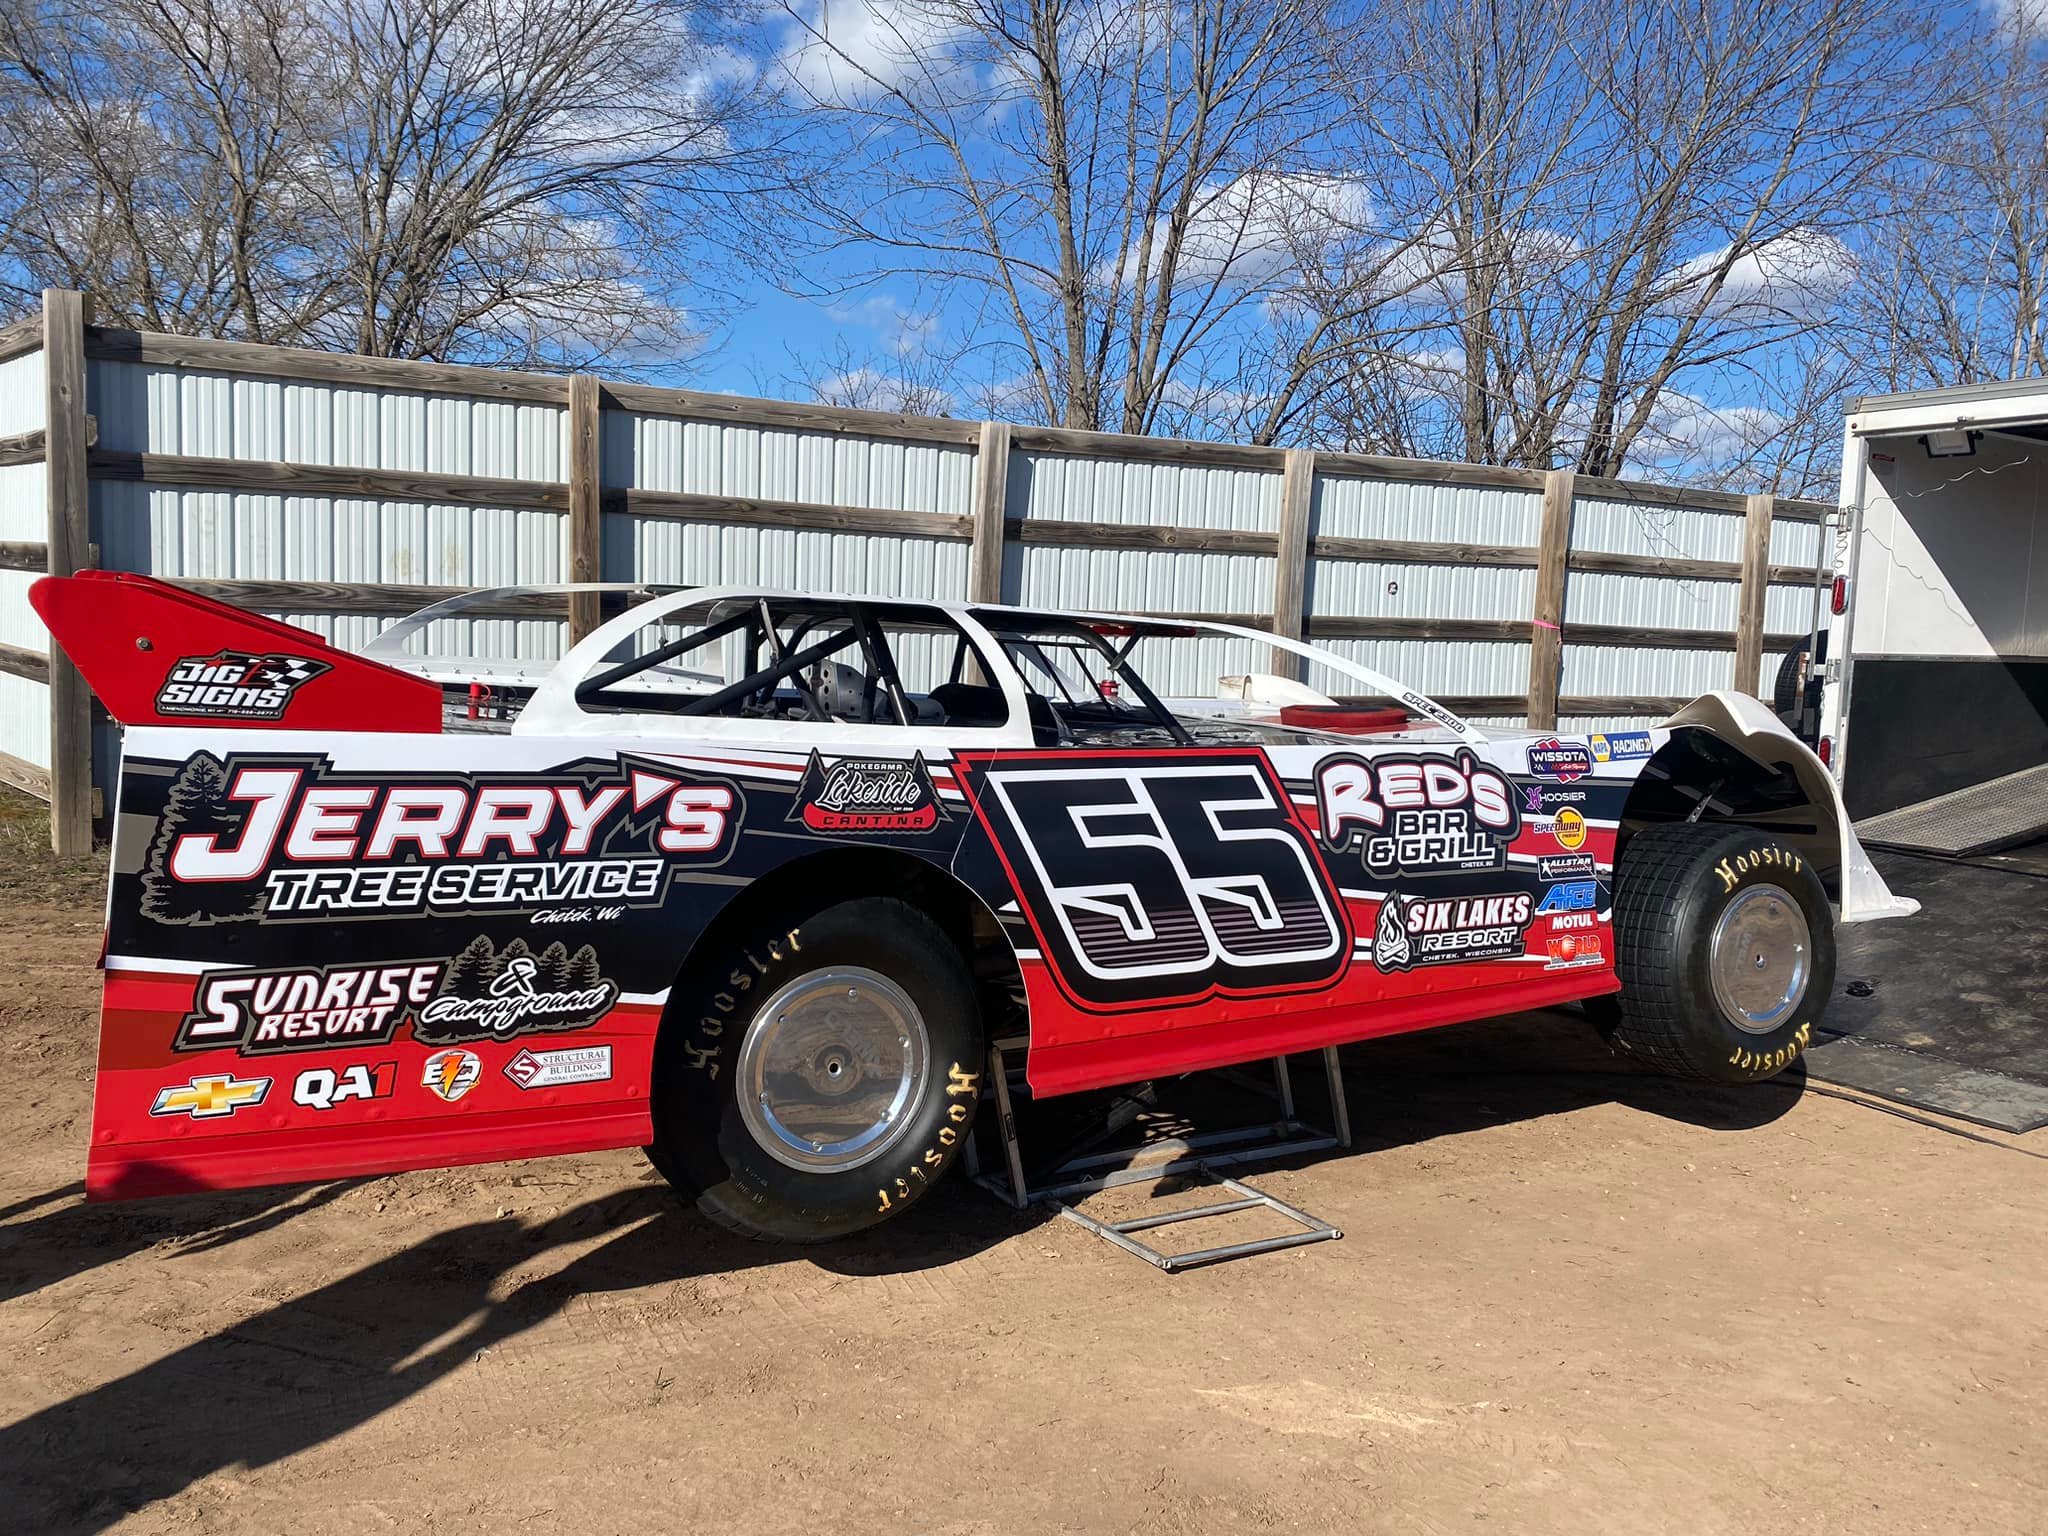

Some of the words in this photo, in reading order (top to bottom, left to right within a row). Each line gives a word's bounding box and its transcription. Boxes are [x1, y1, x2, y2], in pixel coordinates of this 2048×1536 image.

[160, 683, 287, 708] SIGNS
[1402, 691, 1436, 714] SPEC
[1531, 751, 1587, 762] WISSOTA
[1613, 738, 1645, 754] RACING
[846, 762, 904, 771] POKEGAMA
[814, 766, 922, 811] Lakeside
[1321, 758, 1510, 840] RED'S
[1539, 791, 1587, 802] HOOSIER
[170, 767, 733, 883] JERRY'S
[822, 816, 925, 826] CANTINA
[1395, 808, 1468, 839] BAR
[1533, 821, 1581, 834] SPEEDWAY
[1397, 832, 1496, 865] GRILL
[1549, 857, 1592, 867] ALLSTAR
[986, 765, 1341, 980] 55
[1714, 841, 1802, 894] Hoosier
[264, 864, 429, 912] TREE
[425, 858, 665, 910] SERVICE
[1407, 901, 1453, 933] SIX
[1455, 895, 1530, 929] LAKES
[1551, 913, 1593, 931] MOTUL
[1420, 926, 1518, 952] RESORT
[1464, 947, 1512, 958] WISCONSIN
[190, 966, 440, 1036] SUNRISE
[420, 983, 610, 1031] Campground
[255, 1005, 395, 1043] RESORT
[543, 1049, 607, 1064] STRUCTURAL
[1728, 1021, 1812, 1078] Hoosier
[550, 1063, 603, 1075] BUILDINGS
[293, 1062, 400, 1110] QA1
[877, 1061, 981, 1213] Hoosier
